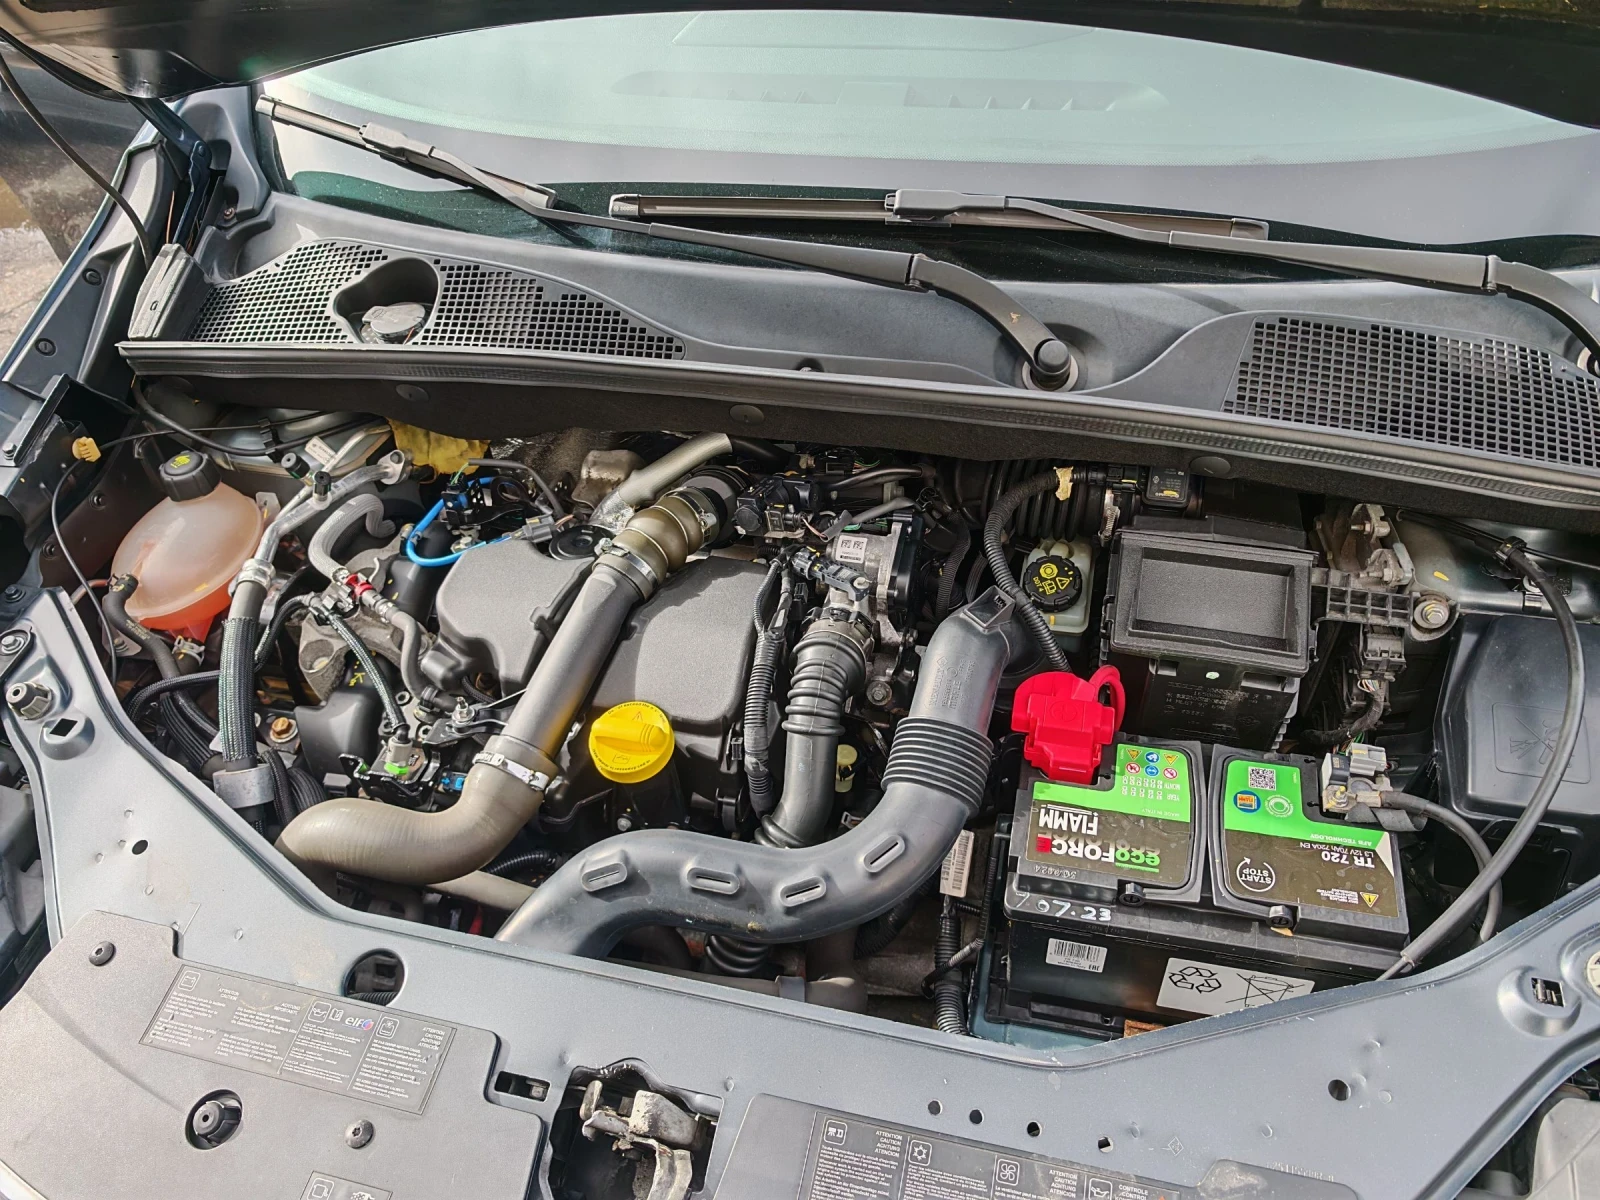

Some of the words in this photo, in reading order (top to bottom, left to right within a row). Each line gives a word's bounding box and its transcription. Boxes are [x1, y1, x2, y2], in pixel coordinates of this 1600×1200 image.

[1033, 576, 1042, 587] DOT
[1038, 808, 1099, 835] FIAMM
[1310, 833, 1356, 844] TECHNOLOGY
[1311, 842, 1330, 851] 720A
[1330, 845, 1349, 854] 70Ah
[1036, 838, 1161, 866] ecoFORCE
[1321, 851, 1350, 864] 720
[1353, 855, 1376, 868] TR
[1242, 867, 1269, 877] STOP
[1239, 873, 1272, 884] START
[344, 1015, 363, 1028] elf
[422, 1026, 445, 1037] ATTENTION
[424, 1032, 443, 1041] CAUTION
[875, 1130, 903, 1141] ATTENTION
[879, 1137, 902, 1146] CAUTION
[876, 1142, 901, 1152] ACHTUNG
[874, 1148, 900, 1158] ATENCION
[1049, 1169, 1078, 1180] ATTENTION
[1054, 1177, 1077, 1186] CAUTION
[1051, 1182, 1076, 1192] ACHTUNG
[1118, 1185, 1148, 1195] CONTROLE
[1049, 1188, 1076, 1198] ATENCION
